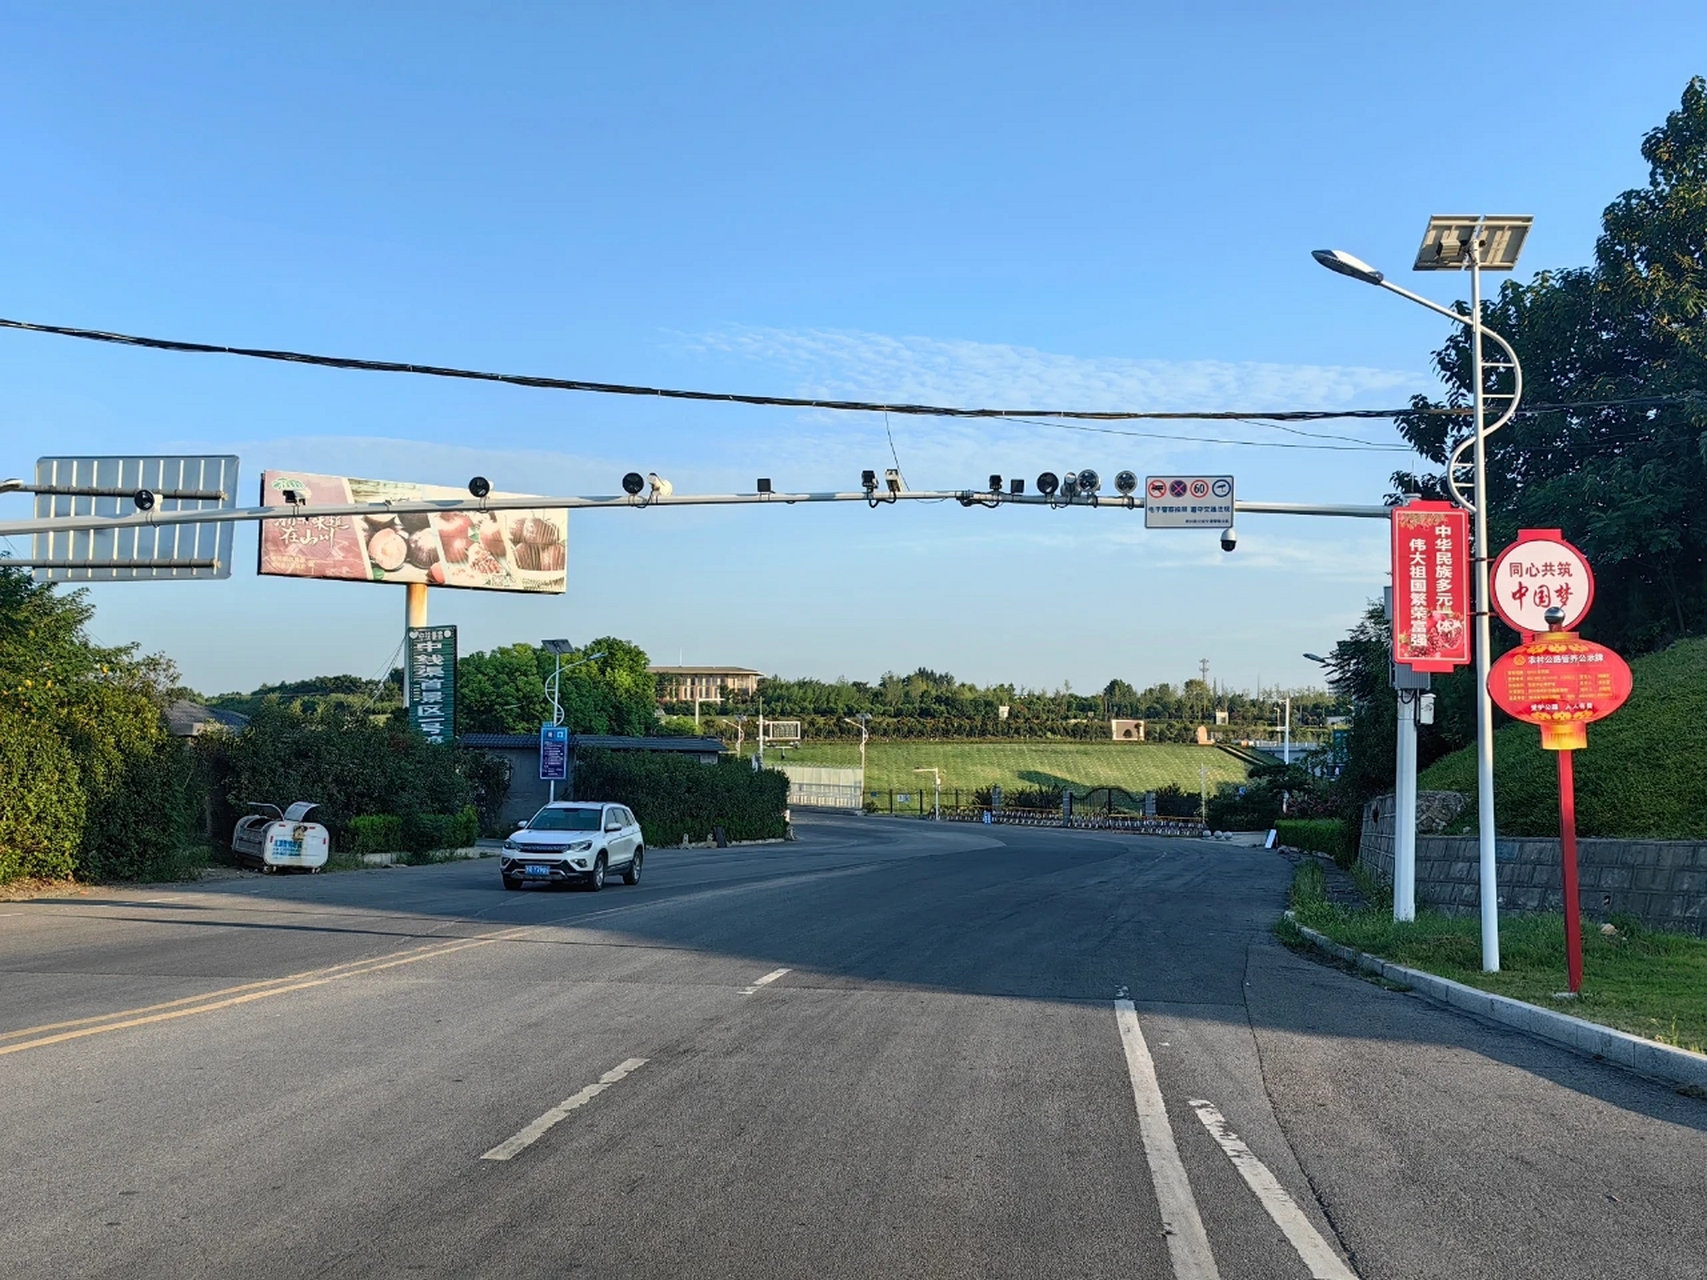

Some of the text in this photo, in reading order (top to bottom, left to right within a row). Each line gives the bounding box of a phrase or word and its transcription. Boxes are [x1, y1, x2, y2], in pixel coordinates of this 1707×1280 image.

[1194, 484, 1205, 494] 60
[279, 526, 336, 550] 在山川
[1434, 525, 1455, 635] 中华民族多元一体
[1510, 562, 1573, 578] 同心共筑
[1409, 538, 1428, 647] 伟大祖国繁荣富强
[1511, 581, 1574, 611] 中国梦
[1531, 702, 1593, 712] 爱护公路 人人有责
